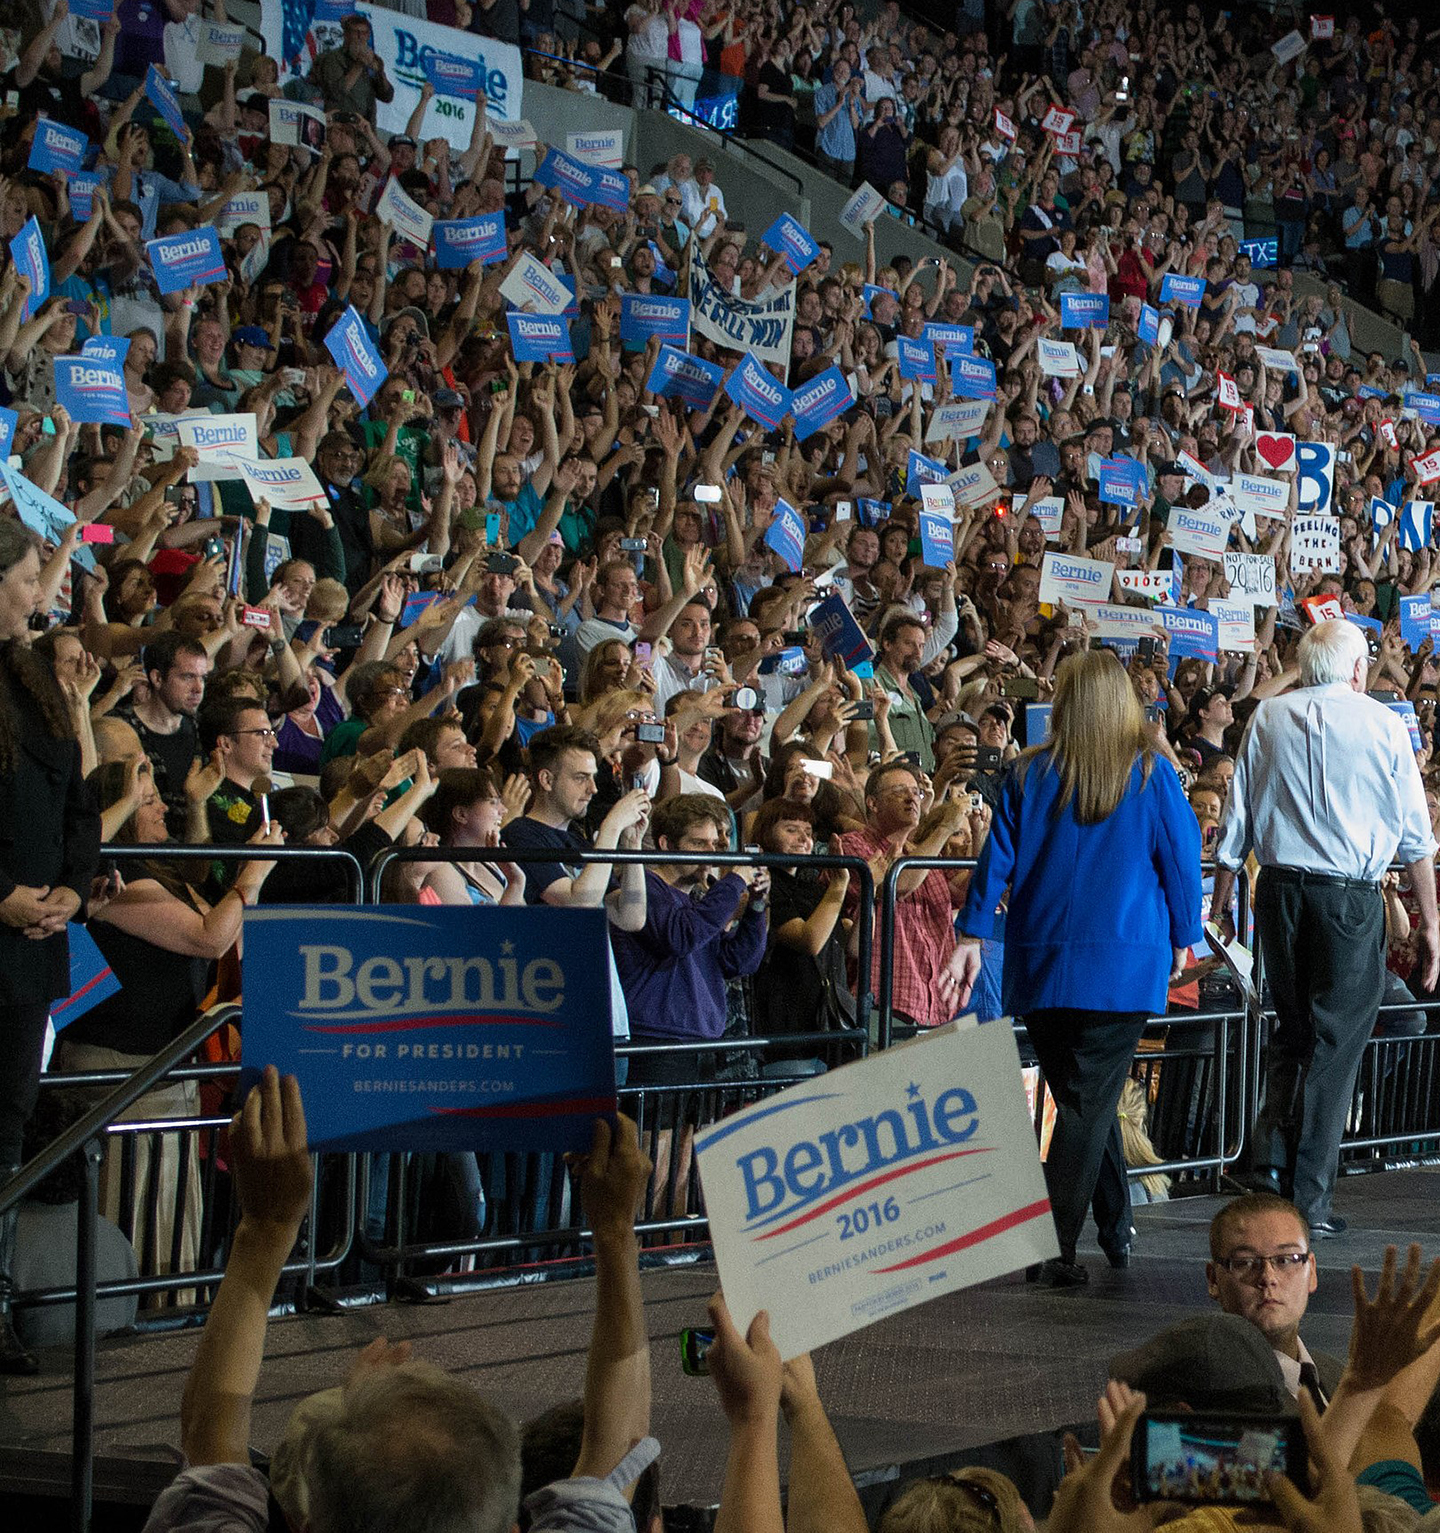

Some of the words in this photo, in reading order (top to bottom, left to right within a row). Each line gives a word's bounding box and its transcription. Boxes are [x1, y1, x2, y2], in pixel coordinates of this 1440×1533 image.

[394, 28, 507, 101] Beie
[434, 100, 464, 121] 2016
[45, 128, 81, 156] Bernie
[575, 137, 615, 151] Bernie
[553, 156, 592, 187] Bernie
[602, 173, 625, 191] rnie
[444, 222, 497, 241] Bernie
[783, 224, 812, 255] Bernie
[158, 238, 211, 263] Bernie
[523, 265, 561, 305] Bernie
[1169, 278, 1200, 292] Bernie
[629, 300, 680, 319] Bernie
[1067, 298, 1104, 311] Bernie
[518, 319, 561, 336] Bernie
[927, 327, 966, 342] Bernie
[81, 343, 116, 359] ernie
[347, 321, 376, 377] Bernie
[664, 354, 712, 381] Bernie
[960, 363, 992, 379] Bernie
[742, 362, 783, 404] Bernie
[790, 373, 837, 414] Bernie
[1409, 395, 1440, 409] Bernie
[940, 407, 981, 422] Bernie
[151, 421, 178, 436] Ber
[193, 425, 246, 444] Bernie
[246, 463, 301, 482] Bernie
[915, 460, 949, 480] Berni
[1423, 458, 1437, 470] 15
[951, 472, 981, 491] rnie
[1241, 480, 1282, 498] Bernie
[1300, 451, 1331, 512] B
[865, 503, 890, 519] Bern
[1029, 504, 1059, 516] ernie
[781, 511, 803, 541] Bern
[927, 520, 952, 540] Bern
[1177, 514, 1221, 536] Bernie
[1293, 521, 1338, 535] FEELING
[1305, 539, 1327, 548] THE
[1226, 553, 1242, 563] NOT
[1050, 560, 1102, 582] Bernie
[1097, 609, 1155, 622] Bernie
[1216, 606, 1250, 628] Bernie
[1320, 607, 1336, 619] 15
[1410, 603, 1430, 617] Ber
[1166, 613, 1213, 635] Bernie
[1110, 642, 1138, 656] Bern
[299, 939, 567, 1012] Bernie
[341, 1044, 387, 1058] FOR
[397, 1043, 525, 1059] PRESIDENT
[353, 1080, 515, 1093] BERNIESANDERS.COM
[735, 1081, 980, 1222] Bernie
[836, 1196, 900, 1241] 2016
[808, 1222, 947, 1285] BERNIESANDERS.COM
